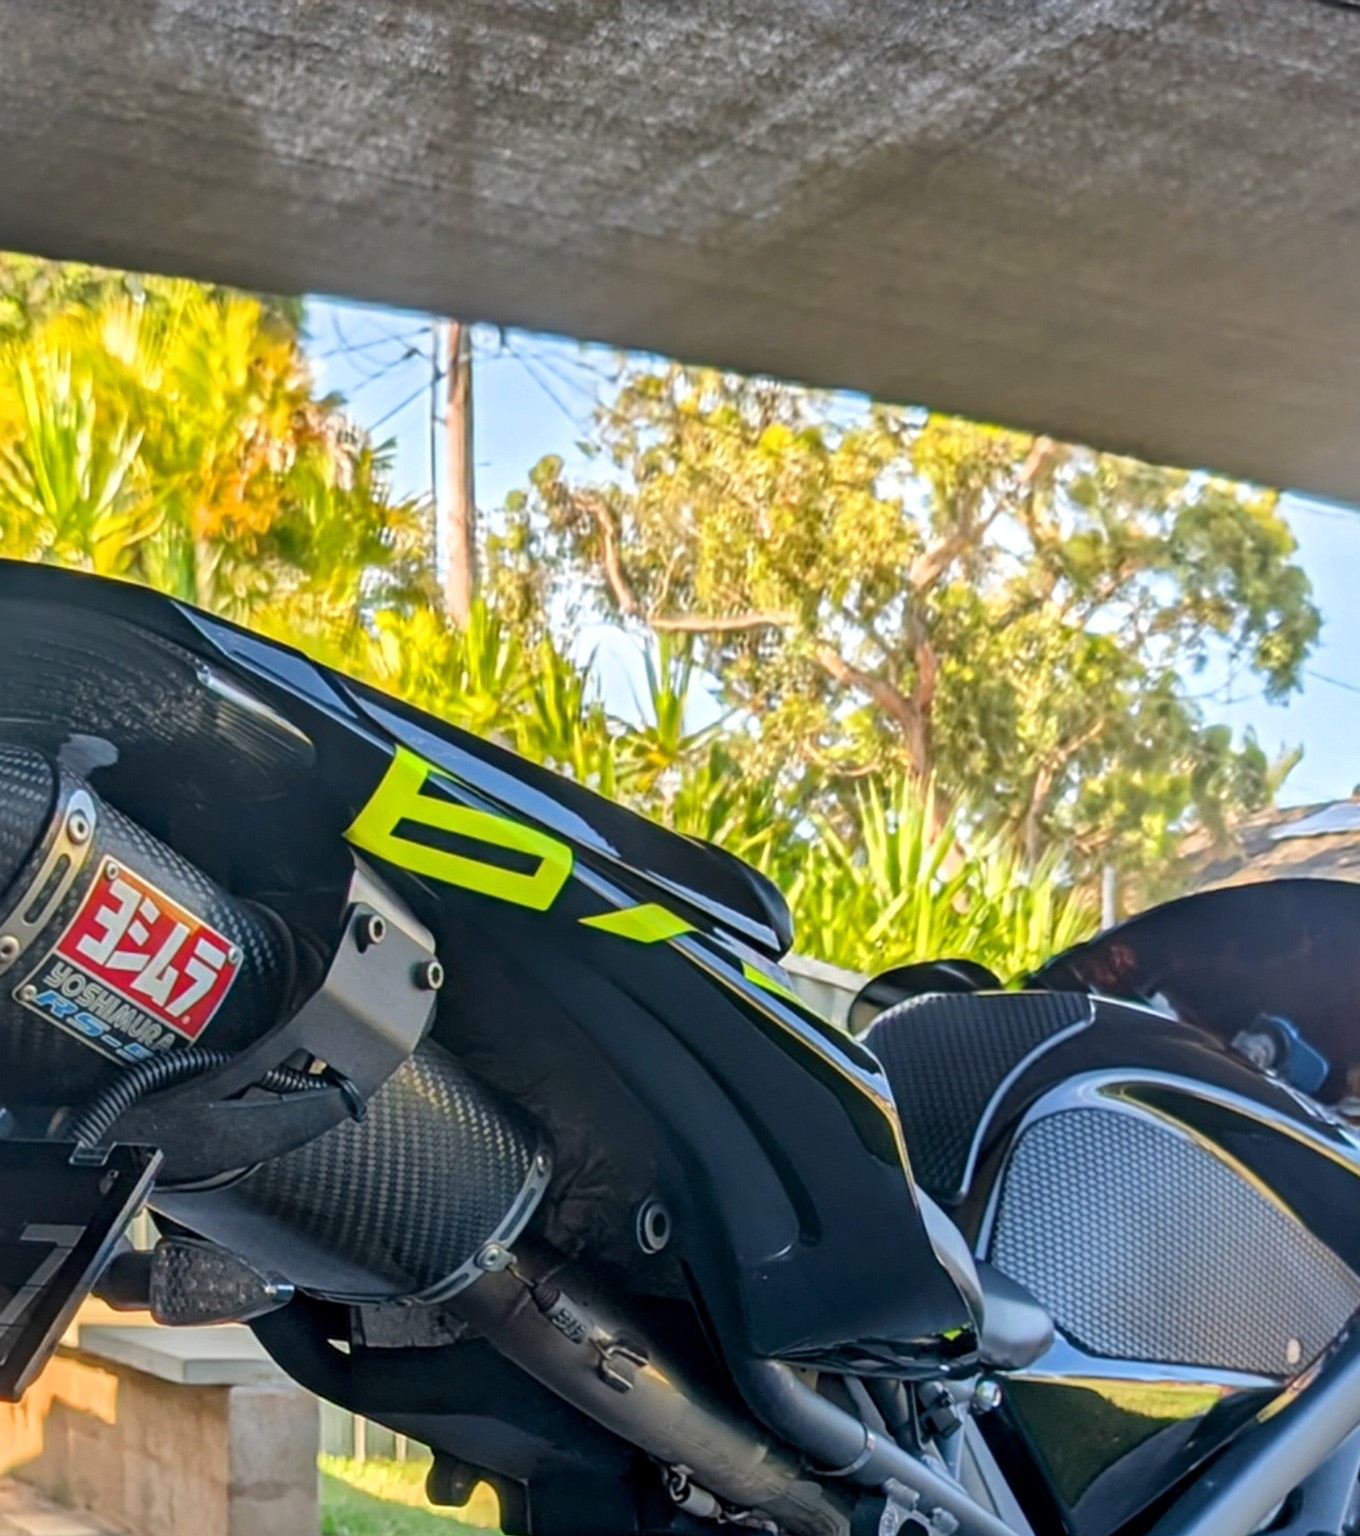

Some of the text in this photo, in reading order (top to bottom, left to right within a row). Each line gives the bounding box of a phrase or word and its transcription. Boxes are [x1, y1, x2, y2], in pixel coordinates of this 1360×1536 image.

[42, 960, 177, 1051] YOSHIMURA
[75, 877, 228, 1019] ヨシムラ
